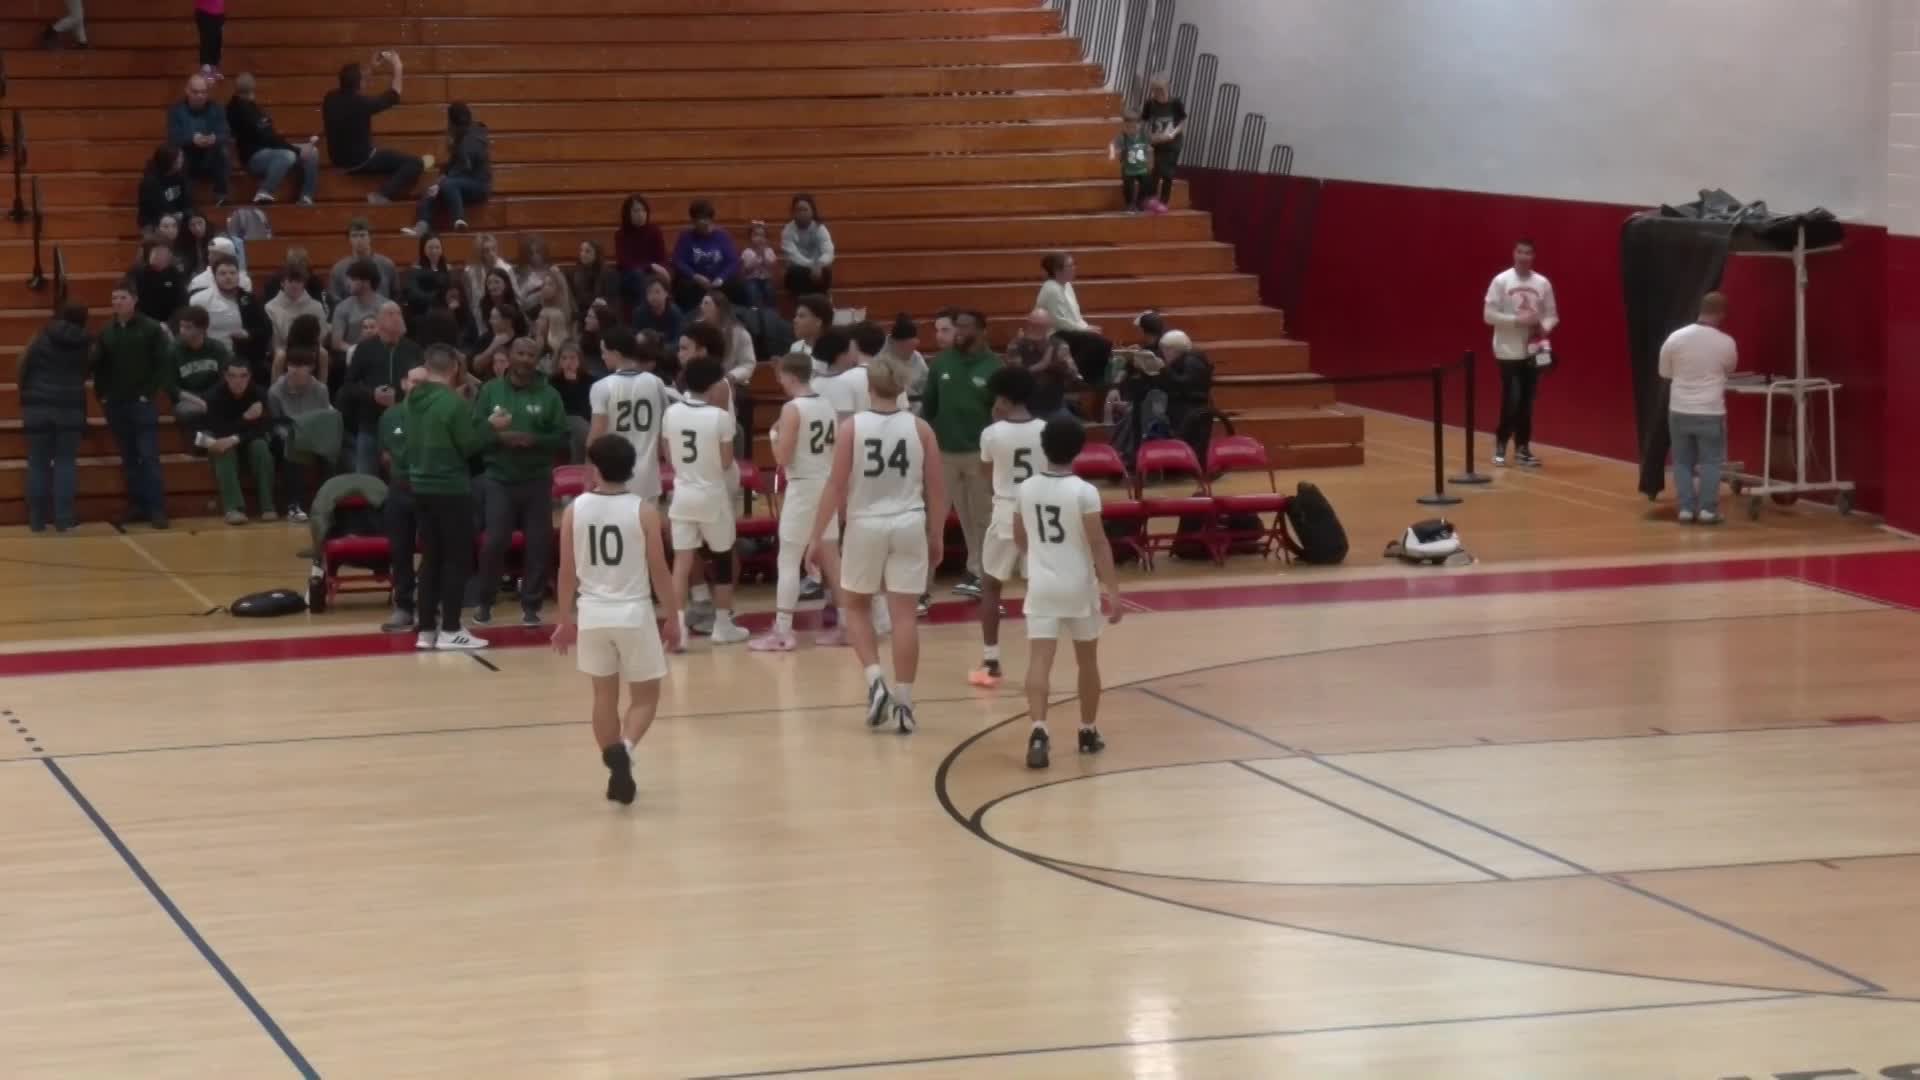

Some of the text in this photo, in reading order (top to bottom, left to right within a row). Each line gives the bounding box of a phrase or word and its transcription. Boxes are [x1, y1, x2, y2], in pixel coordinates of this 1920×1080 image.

[616, 398, 652, 432] 20
[681, 429, 698, 464] 3
[810, 419, 836, 454] 24
[864, 438, 910, 477] 34
[1013, 448, 1033, 484] 5
[1035, 504, 1065, 544] 13
[588, 525, 624, 566] 10
